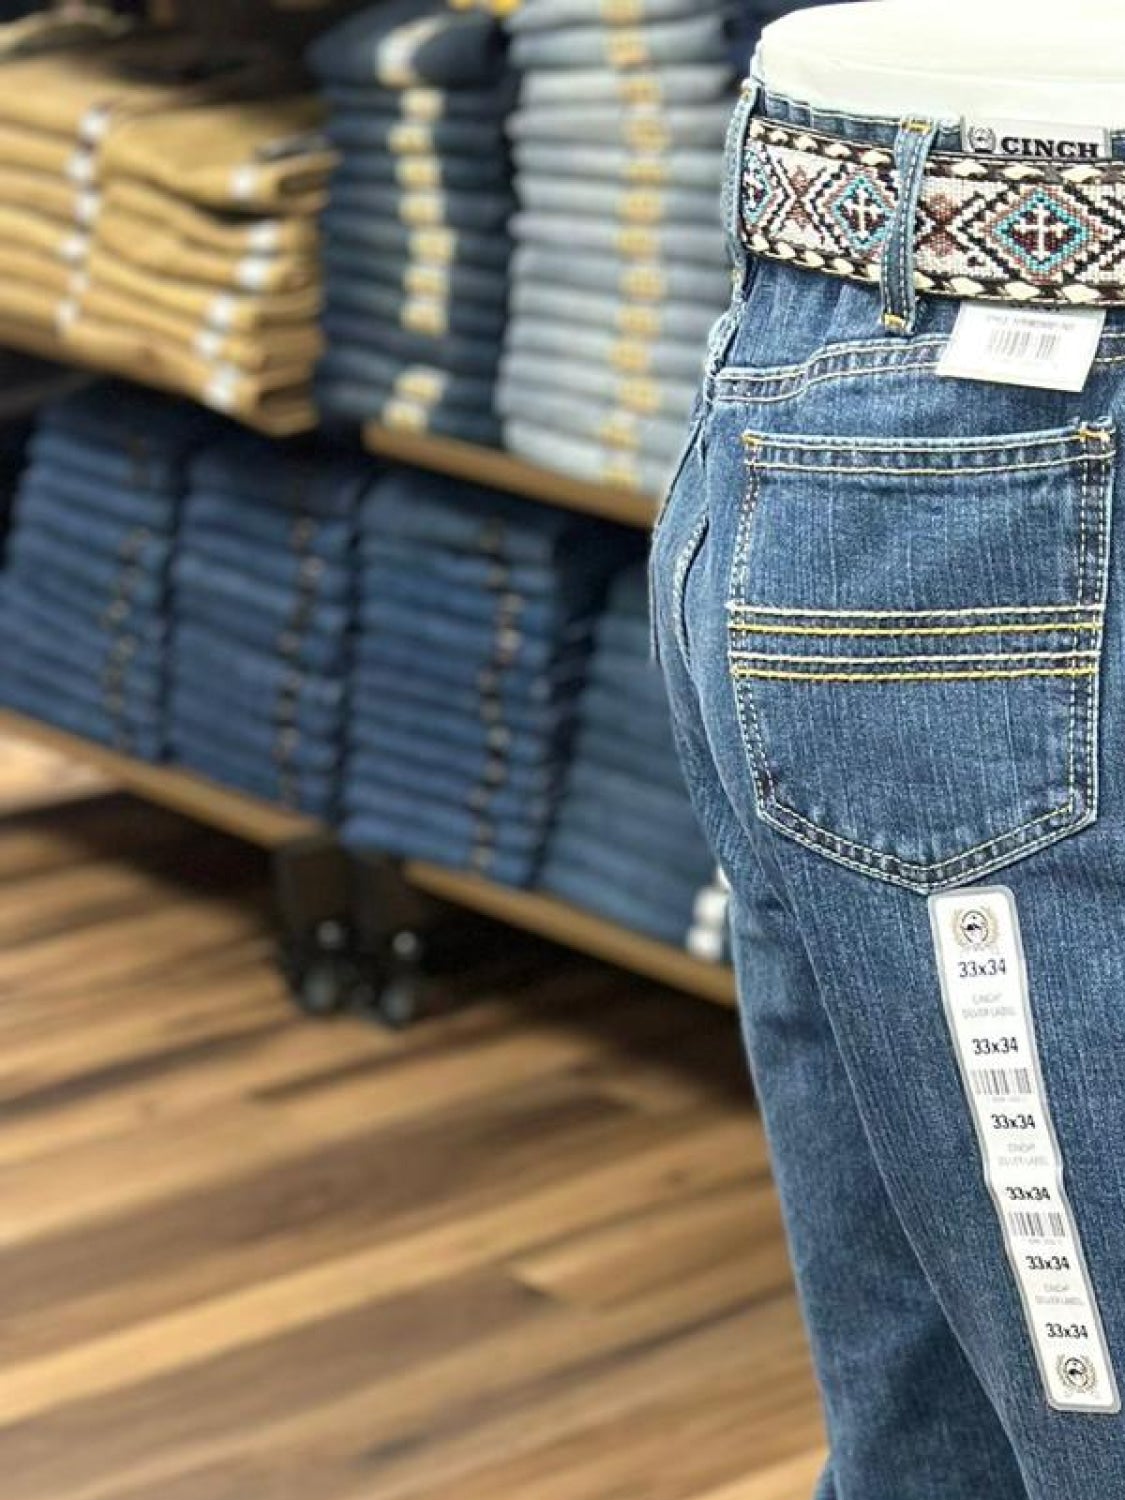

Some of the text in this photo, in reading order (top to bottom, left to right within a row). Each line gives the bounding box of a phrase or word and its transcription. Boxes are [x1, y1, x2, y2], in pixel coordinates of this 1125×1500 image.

[1000, 136, 1099, 158] CINCH
[959, 958, 1006, 977] 33x34
[972, 1037, 1019, 1054] 33x34
[992, 1114, 1036, 1130] 33x34
[1006, 1186, 1051, 1201] 33x34
[1026, 1255, 1070, 1271] 33x34
[1045, 1322, 1089, 1339] 33x34
